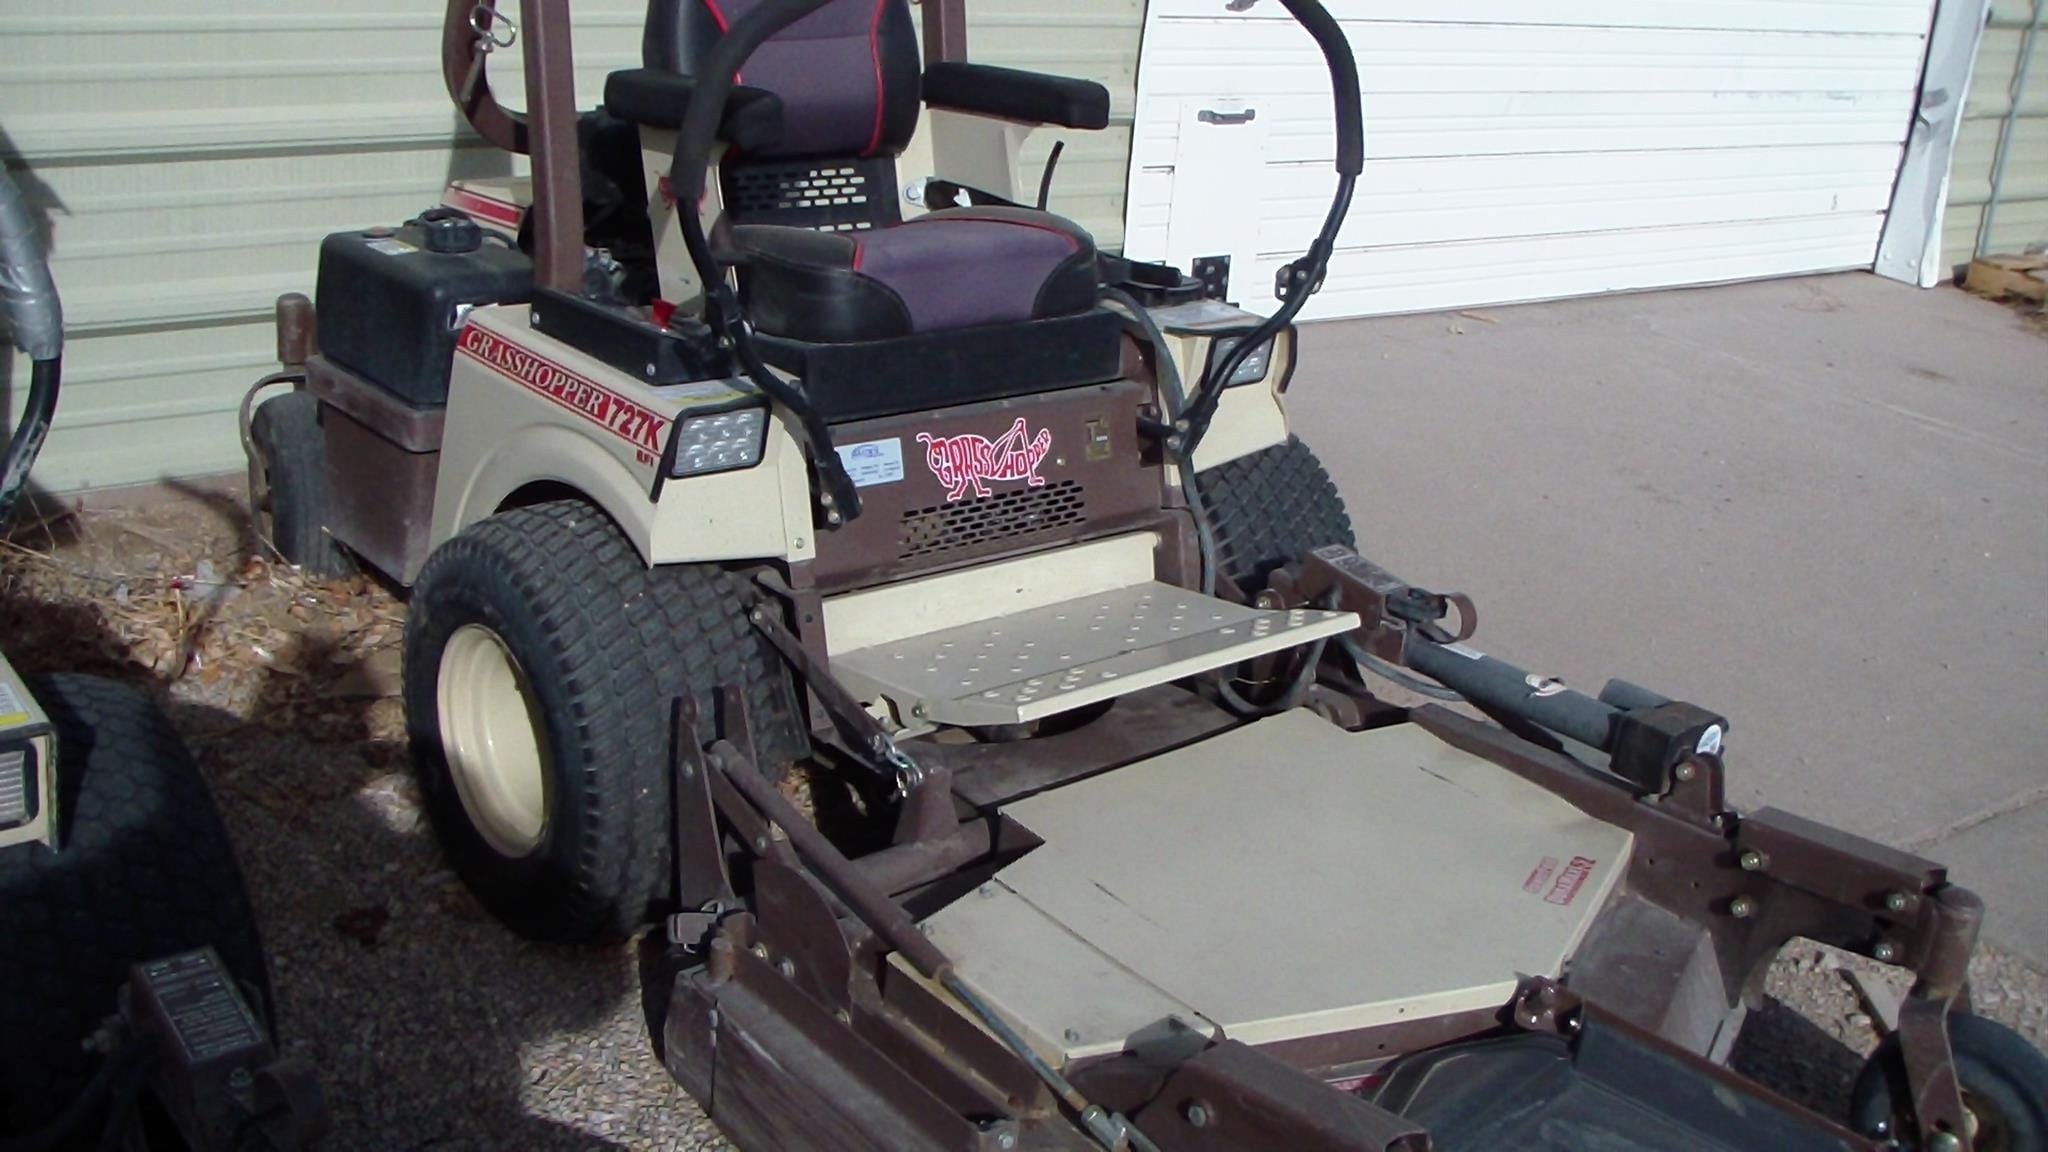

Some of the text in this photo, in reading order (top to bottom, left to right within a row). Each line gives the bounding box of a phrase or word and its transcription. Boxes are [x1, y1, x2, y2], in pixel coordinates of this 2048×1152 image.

[466, 329, 665, 451] GRASSHOPPER 727K
[916, 417, 1052, 501] GRASSHOPPER
